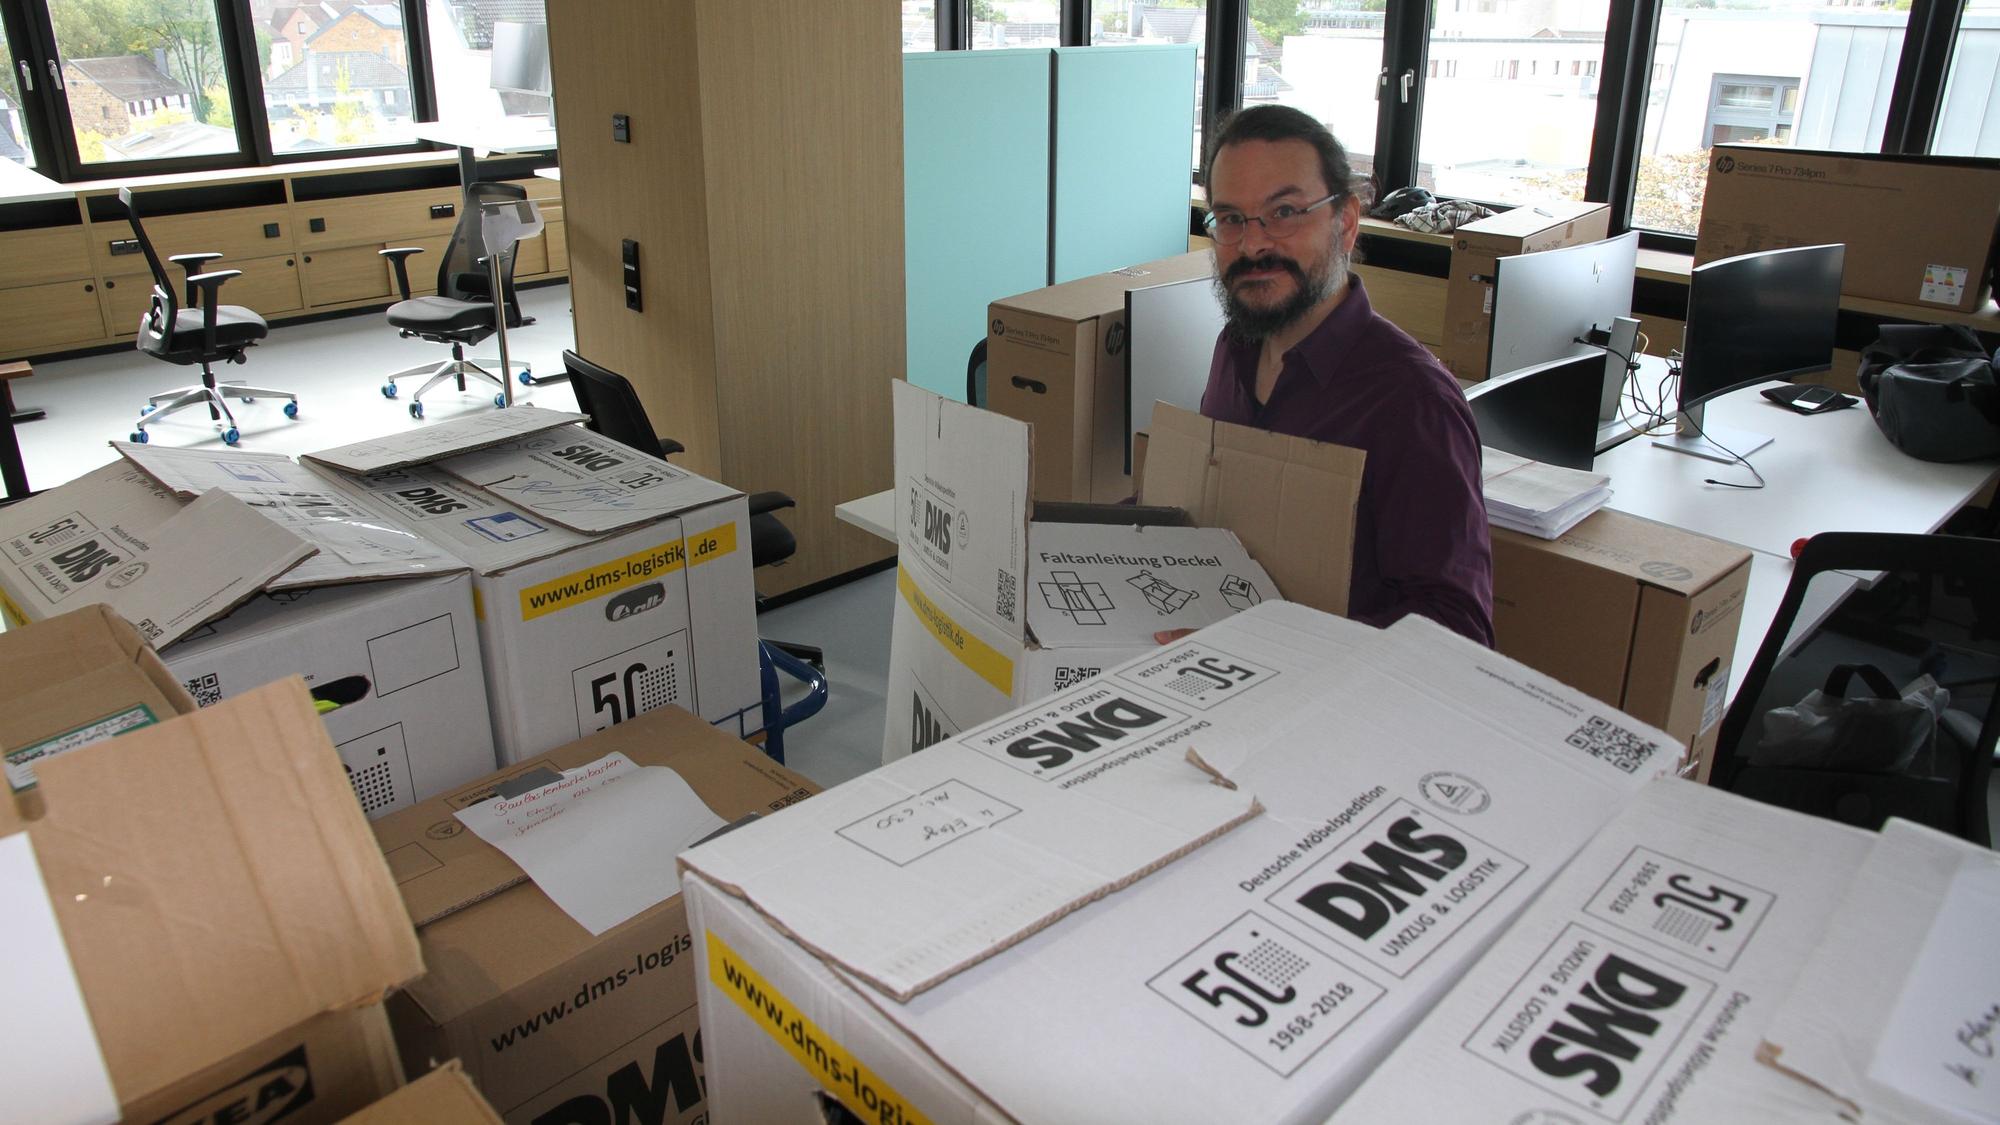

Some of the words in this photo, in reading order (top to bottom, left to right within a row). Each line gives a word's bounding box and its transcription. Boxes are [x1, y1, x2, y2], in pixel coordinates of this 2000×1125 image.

[1716, 156, 1735, 174] hp
[1775, 164, 1791, 175] Pro
[552, 445, 624, 471] DMS
[396, 487, 468, 515] DMS
[924, 499, 952, 555] DMS
[50, 539, 120, 583] DMS
[1039, 552, 1162, 569] Faltanleitung
[1163, 555, 1222, 568] Deckel
[1138, 648, 1201, 679] 1968-2018
[911, 689, 951, 755] DM
[1060, 688, 1111, 712] UMZUG
[983, 717, 1045, 746] LOGISTIK
[1006, 697, 1168, 769] DMS
[1150, 719, 1213, 754] Deutsche
[1056, 742, 1153, 790] Möbelspedition
[1239, 845, 1303, 894] Deutsche
[1301, 783, 1387, 857] Möbelspedition
[1295, 815, 1468, 942] DMS
[1608, 861, 1661, 916] 1968-2018
[1379, 912, 1436, 958] UMZUG
[1433, 898, 1452, 917] &
[1450, 856, 1502, 906] LOGISTIK
[1551, 940, 1596, 986] UMZUG
[490, 932, 694, 1053] www.dms-logis
[1267, 980, 1355, 1053] 1968-2018
[1496, 995, 1543, 1053] LOGISTIK
[1528, 952, 1688, 1099] DMS
